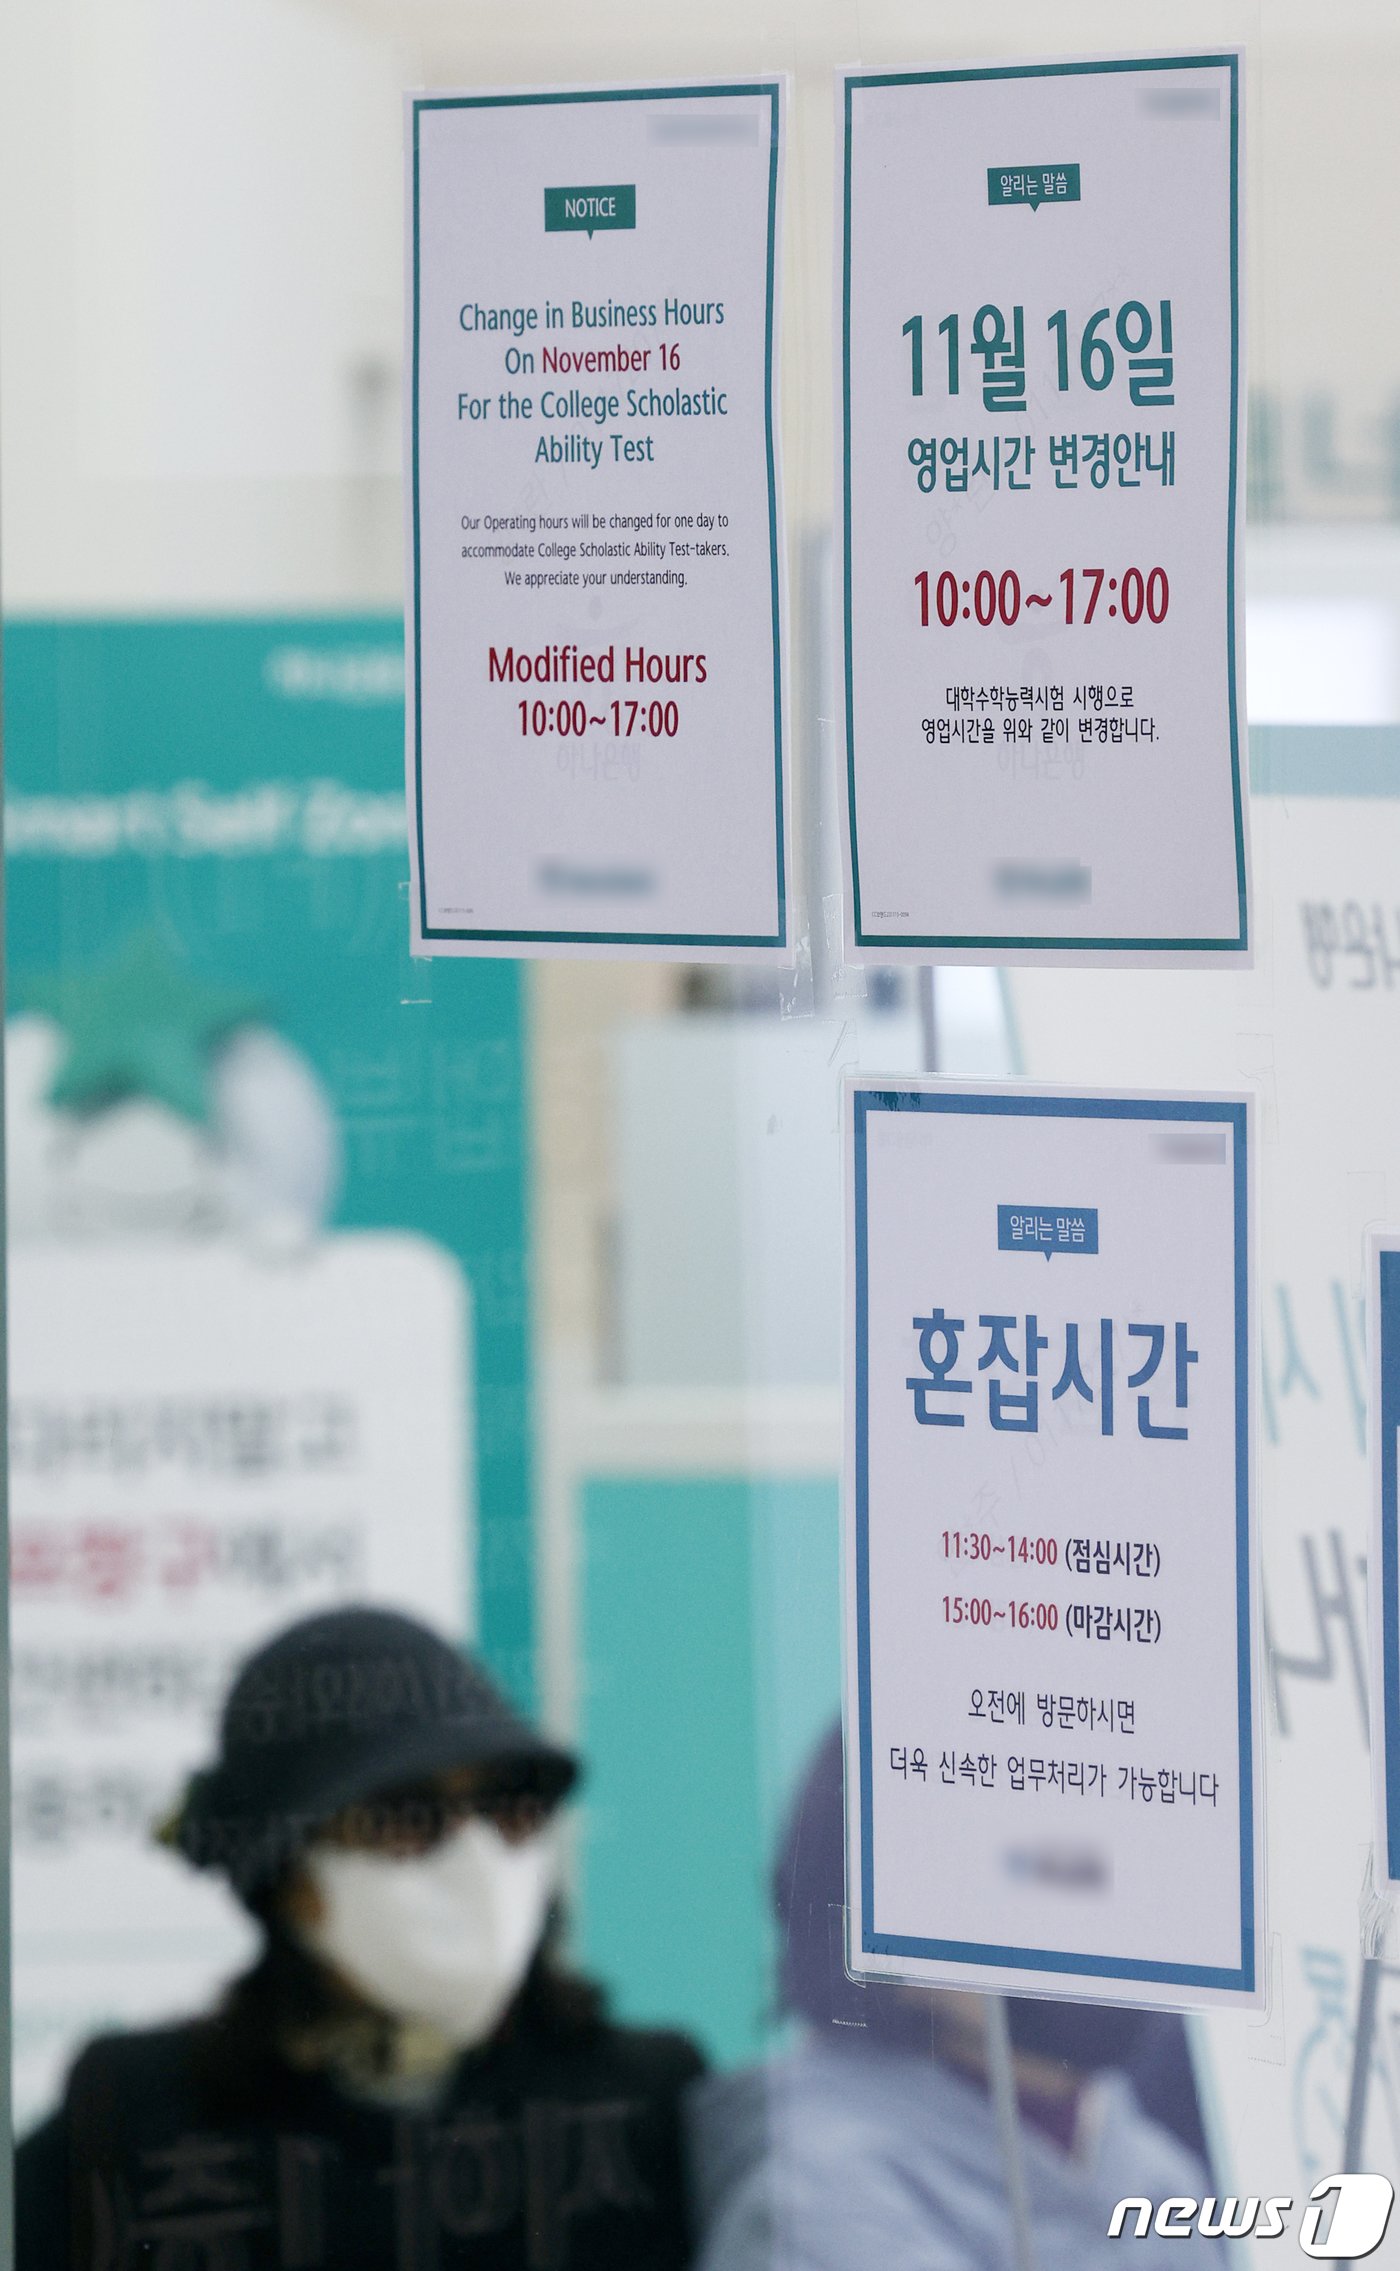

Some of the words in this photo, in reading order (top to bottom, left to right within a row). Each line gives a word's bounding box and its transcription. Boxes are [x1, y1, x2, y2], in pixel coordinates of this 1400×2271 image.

[1001, 174, 1038, 196] 알리는
[1043, 173, 1067, 194] 말씀
[566, 197, 616, 217] NOTICE
[460, 303, 537, 336] Change
[546, 301, 563, 328] in
[572, 299, 656, 328] Business
[665, 299, 724, 325] Hours
[505, 348, 534, 374] On
[543, 344, 651, 373] November
[660, 343, 680, 370] 16
[903, 304, 1026, 412] 11월
[1048, 300, 1174, 406] 16일
[459, 393, 491, 420] For
[499, 391, 532, 419] the
[541, 390, 619, 424] College
[627, 387, 727, 416] Scholastic
[535, 435, 603, 469] Ability
[610, 435, 654, 461] Test
[908, 436, 1035, 493] 영업시간
[1050, 431, 1174, 489] 변경안내
[461, 516, 480, 530] Our
[484, 515, 536, 532] Operating
[539, 515, 568, 529] hours
[572, 514, 589, 528] will
[593, 514, 606, 528] be
[610, 513, 653, 531] changed
[656, 513, 671, 528] for
[675, 516, 693, 527] one
[697, 513, 714, 530] day
[718, 514, 728, 527] to
[462, 543, 534, 558] accommodate
[538, 542, 576, 560] College
[580, 542, 630, 556] Scholastic
[634, 542, 666, 559] Ability
[669, 541, 729, 556] Test-takers.
[505, 572, 521, 585] We
[525, 571, 579, 588] appreciate
[583, 574, 607, 588] your
[611, 570, 687, 588] understanding.
[915, 567, 1169, 627] 10:00~17:00
[489, 645, 614, 682] Modified
[626, 647, 706, 683] Hours
[946, 686, 1063, 711] 대학수학능력시험
[1073, 685, 1134, 711] 시행으로
[519, 700, 678, 737] 10:00~17:00
[922, 718, 995, 744] 영업시간을
[1003, 719, 1033, 743] 위와
[1041, 718, 1068, 743] 같이
[1079, 717, 1159, 743] 변경합니다.
[1011, 1216, 1053, 1240] 알리는
[1057, 1218, 1085, 1242] 말씀
[906, 1308, 1198, 1440] 혼잡시간
[943, 1531, 1057, 1565] 11:30~14:00
[1066, 1539, 1160, 1577] (점심시간)
[943, 1596, 1058, 1630] 15:00~16:00
[1066, 1604, 1161, 1643] (마감시간)
[968, 1689, 1024, 1725] 오전에
[1037, 1694, 1134, 1734] 방문하시면
[891, 1747, 928, 1782] 더욱
[940, 1751, 997, 1787] 신속한
[1008, 1756, 1107, 1797] 업무처리가
[1119, 1767, 1219, 1807] 가능합니다
